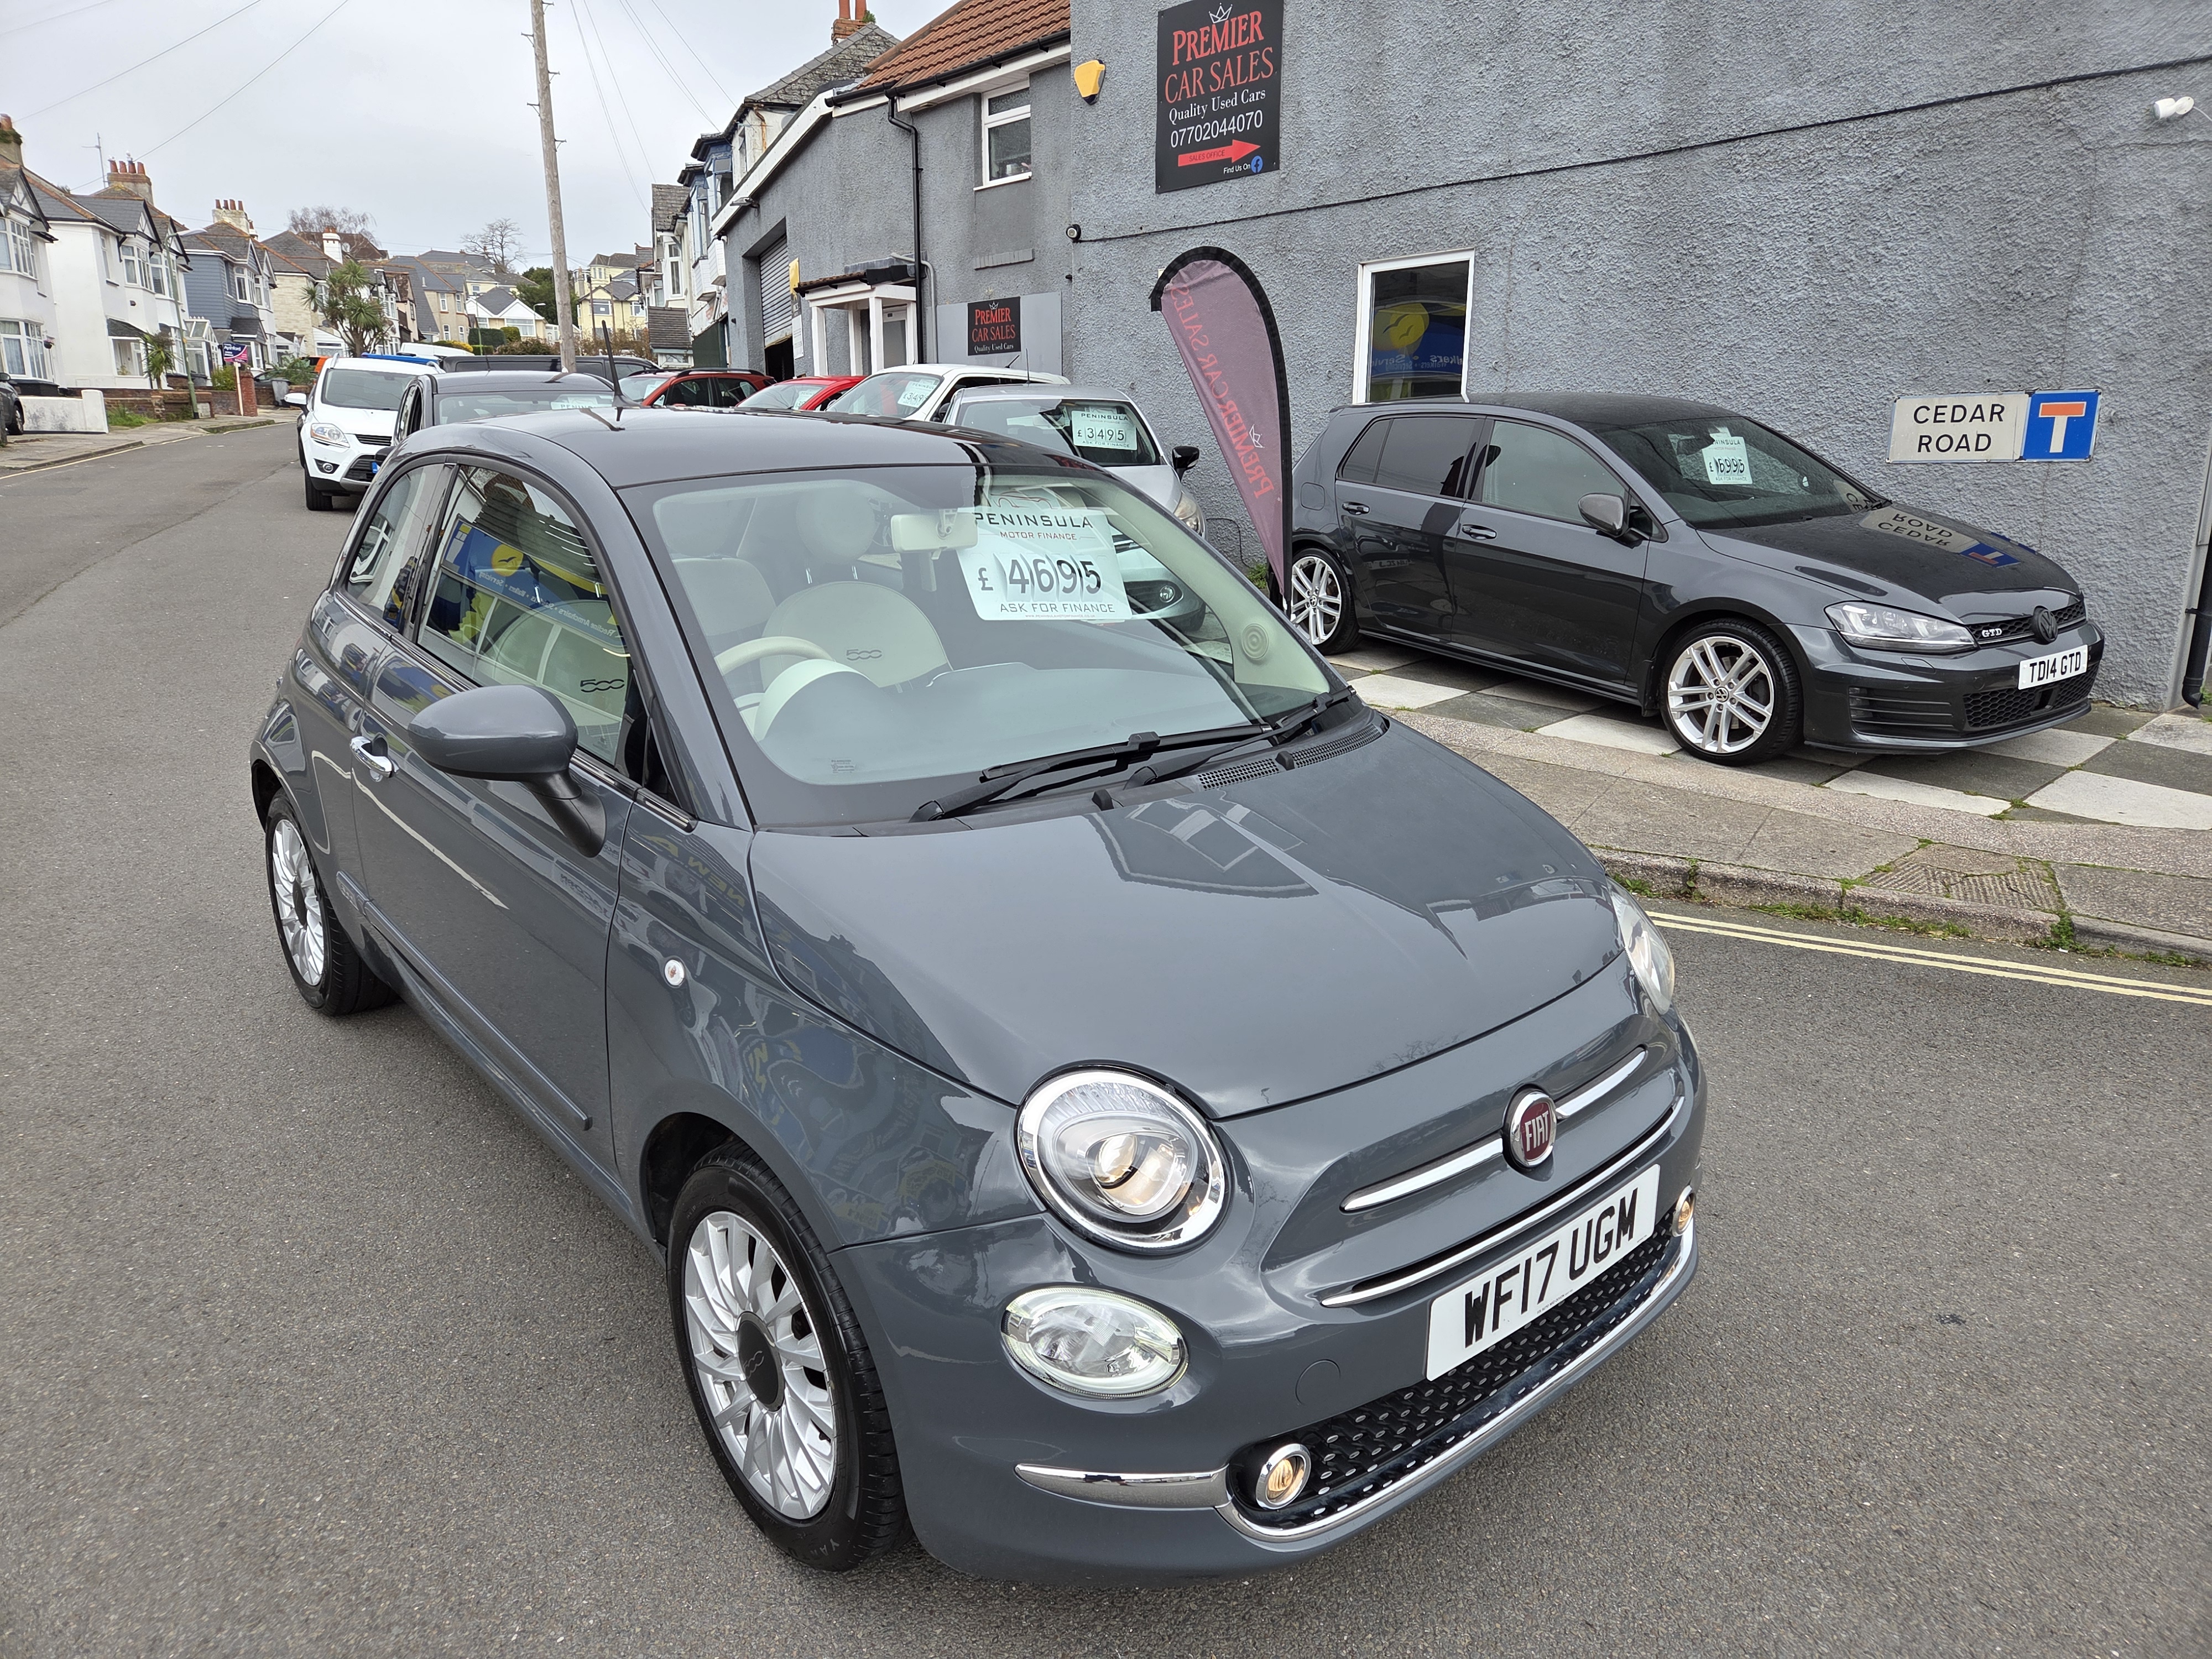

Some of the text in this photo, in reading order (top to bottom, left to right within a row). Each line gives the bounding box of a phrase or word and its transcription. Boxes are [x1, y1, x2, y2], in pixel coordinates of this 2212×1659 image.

[1172, 11, 1264, 66] PREMIER
[1165, 46, 1274, 104] CAR SALES
[1169, 89, 1266, 125] Quality Used Cars
[1171, 110, 1263, 148] 07702044070
[1189, 149, 1225, 161] SALES OFFICE
[1223, 163, 1234, 174] Find
[1235, 164, 1242, 172] Us
[975, 307, 1011, 325] PREMIER
[972, 324, 1016, 342] CAR SALES
[974, 345, 990, 353] Quality
[1913, 403, 2005, 424] CEDAR
[1917, 433, 1992, 453] ROAD
[973, 513, 1093, 528] PENINSULA
[1037, 532, 1077, 540] FINANCE
[1000, 603, 1116, 612] ASK FOR FINANCE
[1981, 628, 2002, 638] GTD
[846, 649, 883, 661] 500
[2030, 651, 2081, 684] TD14 GTD
[580, 678, 625, 693] 500
[1524, 1109, 1550, 1152] FIAT
[1464, 1187, 1639, 1349] WF17 UGM
